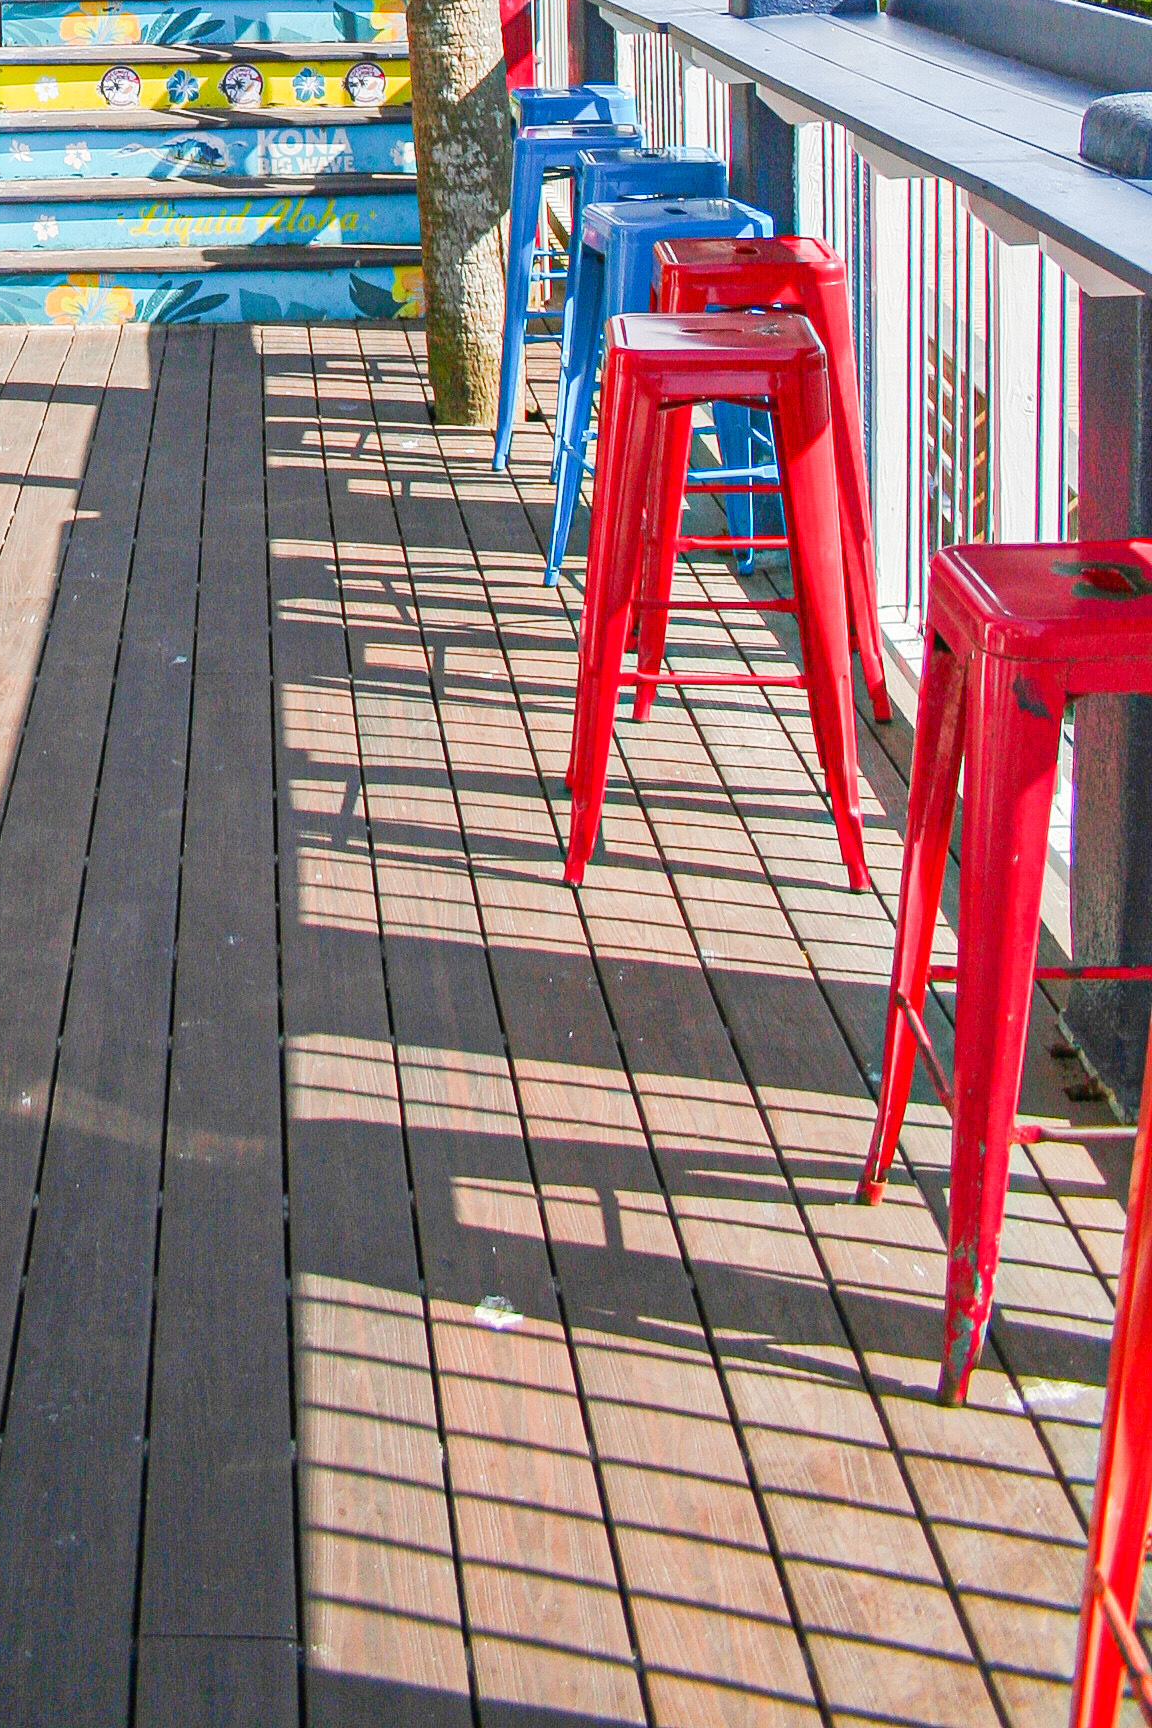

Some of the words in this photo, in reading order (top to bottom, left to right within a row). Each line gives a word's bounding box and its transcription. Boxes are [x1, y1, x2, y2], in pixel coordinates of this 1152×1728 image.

[257, 128, 353, 157] KONA
[258, 157, 293, 174] BIG
[298, 155, 356, 174] WAVE
[130, 200, 253, 246] Liquid
[255, 198, 360, 234] Aloha
